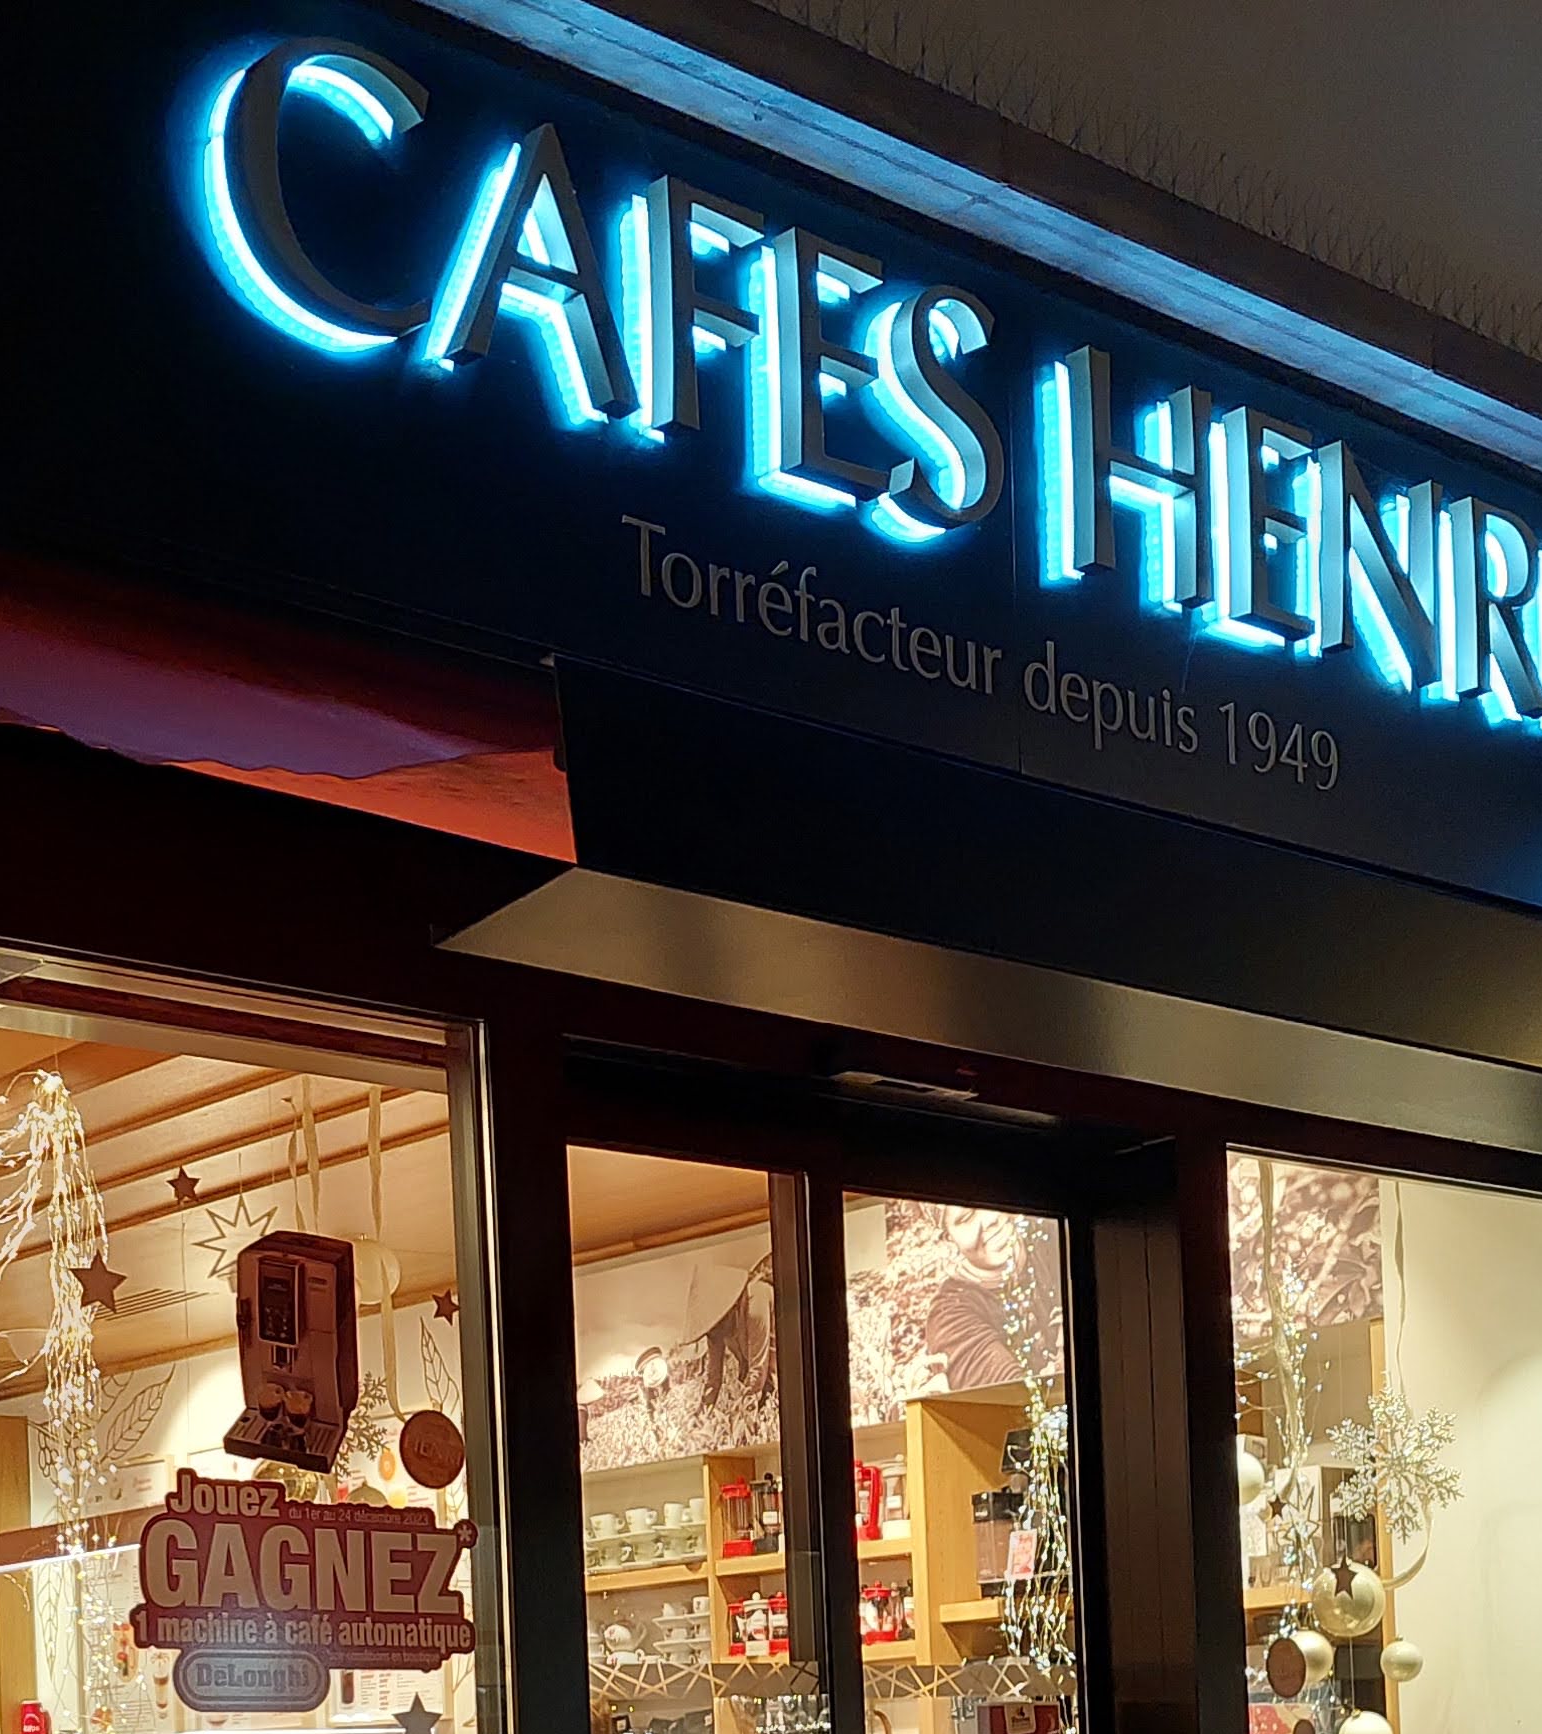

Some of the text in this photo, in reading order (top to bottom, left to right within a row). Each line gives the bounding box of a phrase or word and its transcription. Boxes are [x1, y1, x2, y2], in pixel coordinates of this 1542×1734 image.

[621, 514, 1343, 794] Torréfacteur depuis 1949
[170, 1474, 280, 1516] Jouez
[338, 1509, 352, 1522] 24
[402, 1512, 429, 1526] 2023
[135, 1610, 471, 1655] 1 machine à café automatique
